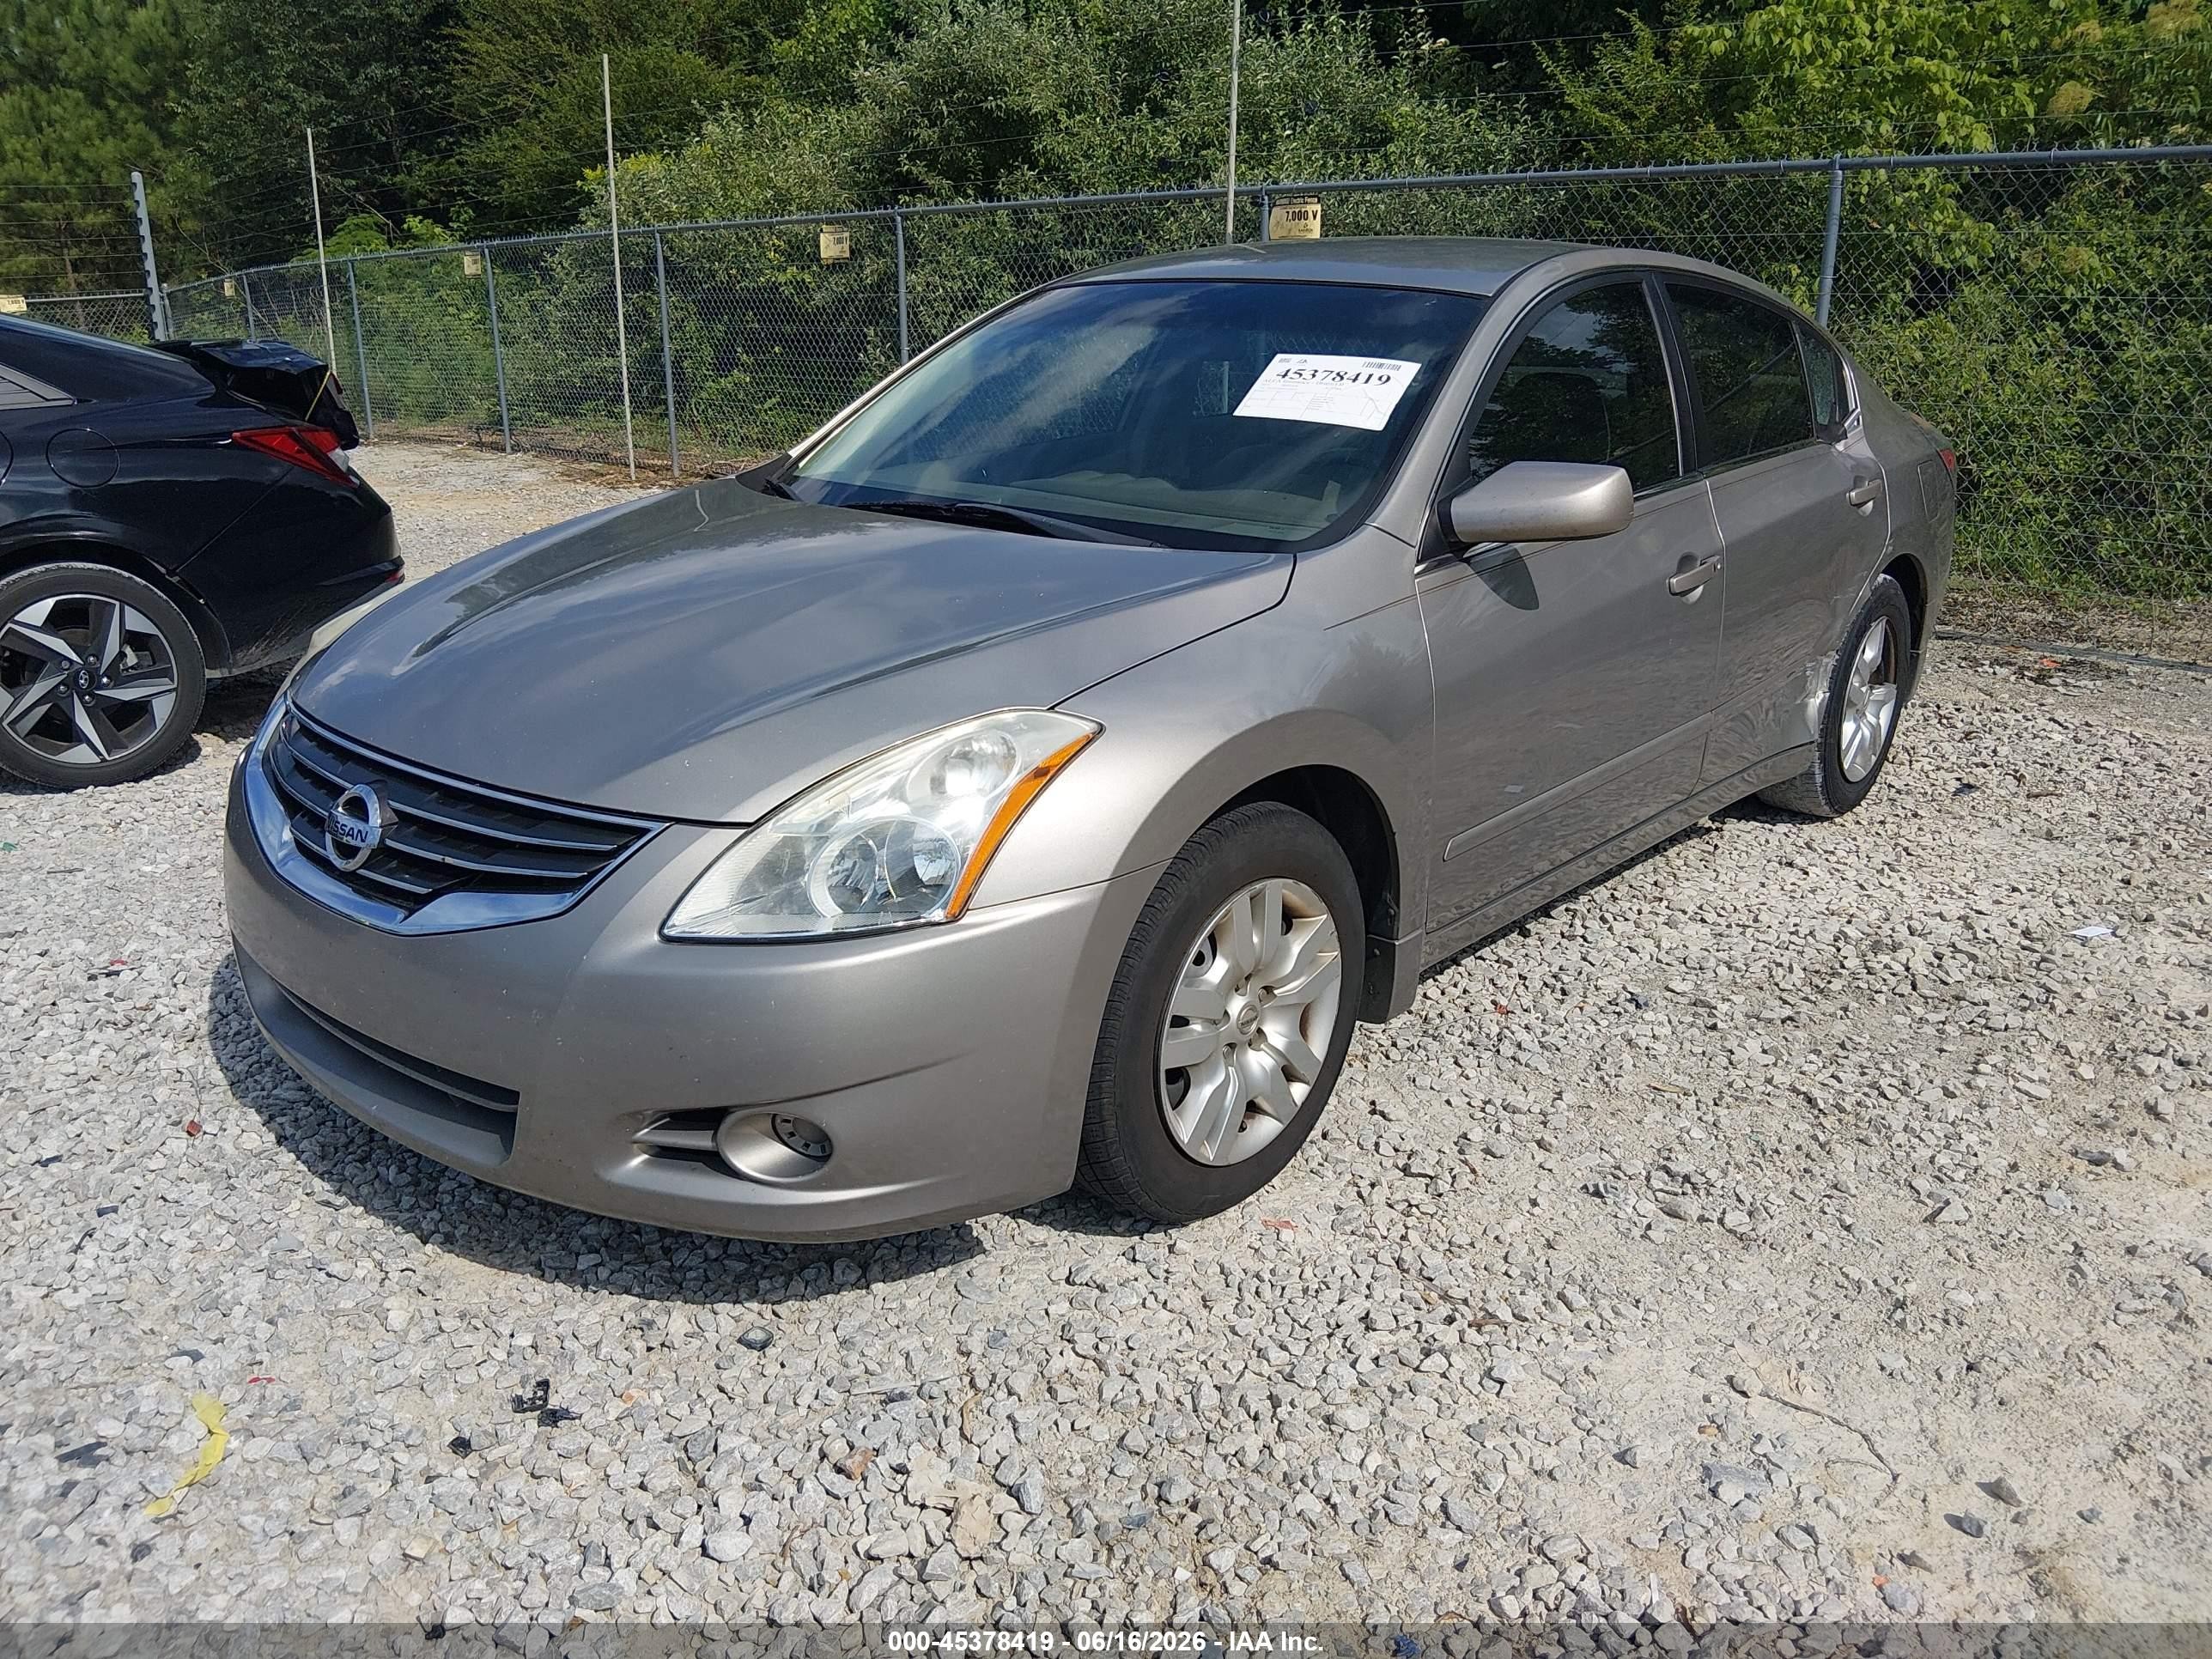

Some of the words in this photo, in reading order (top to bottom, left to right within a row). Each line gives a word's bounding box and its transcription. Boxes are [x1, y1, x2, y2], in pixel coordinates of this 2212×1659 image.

[1285, 210, 1309, 222] 7,000
[1312, 210, 1318, 221] V
[1276, 368, 1391, 386] 45378419
